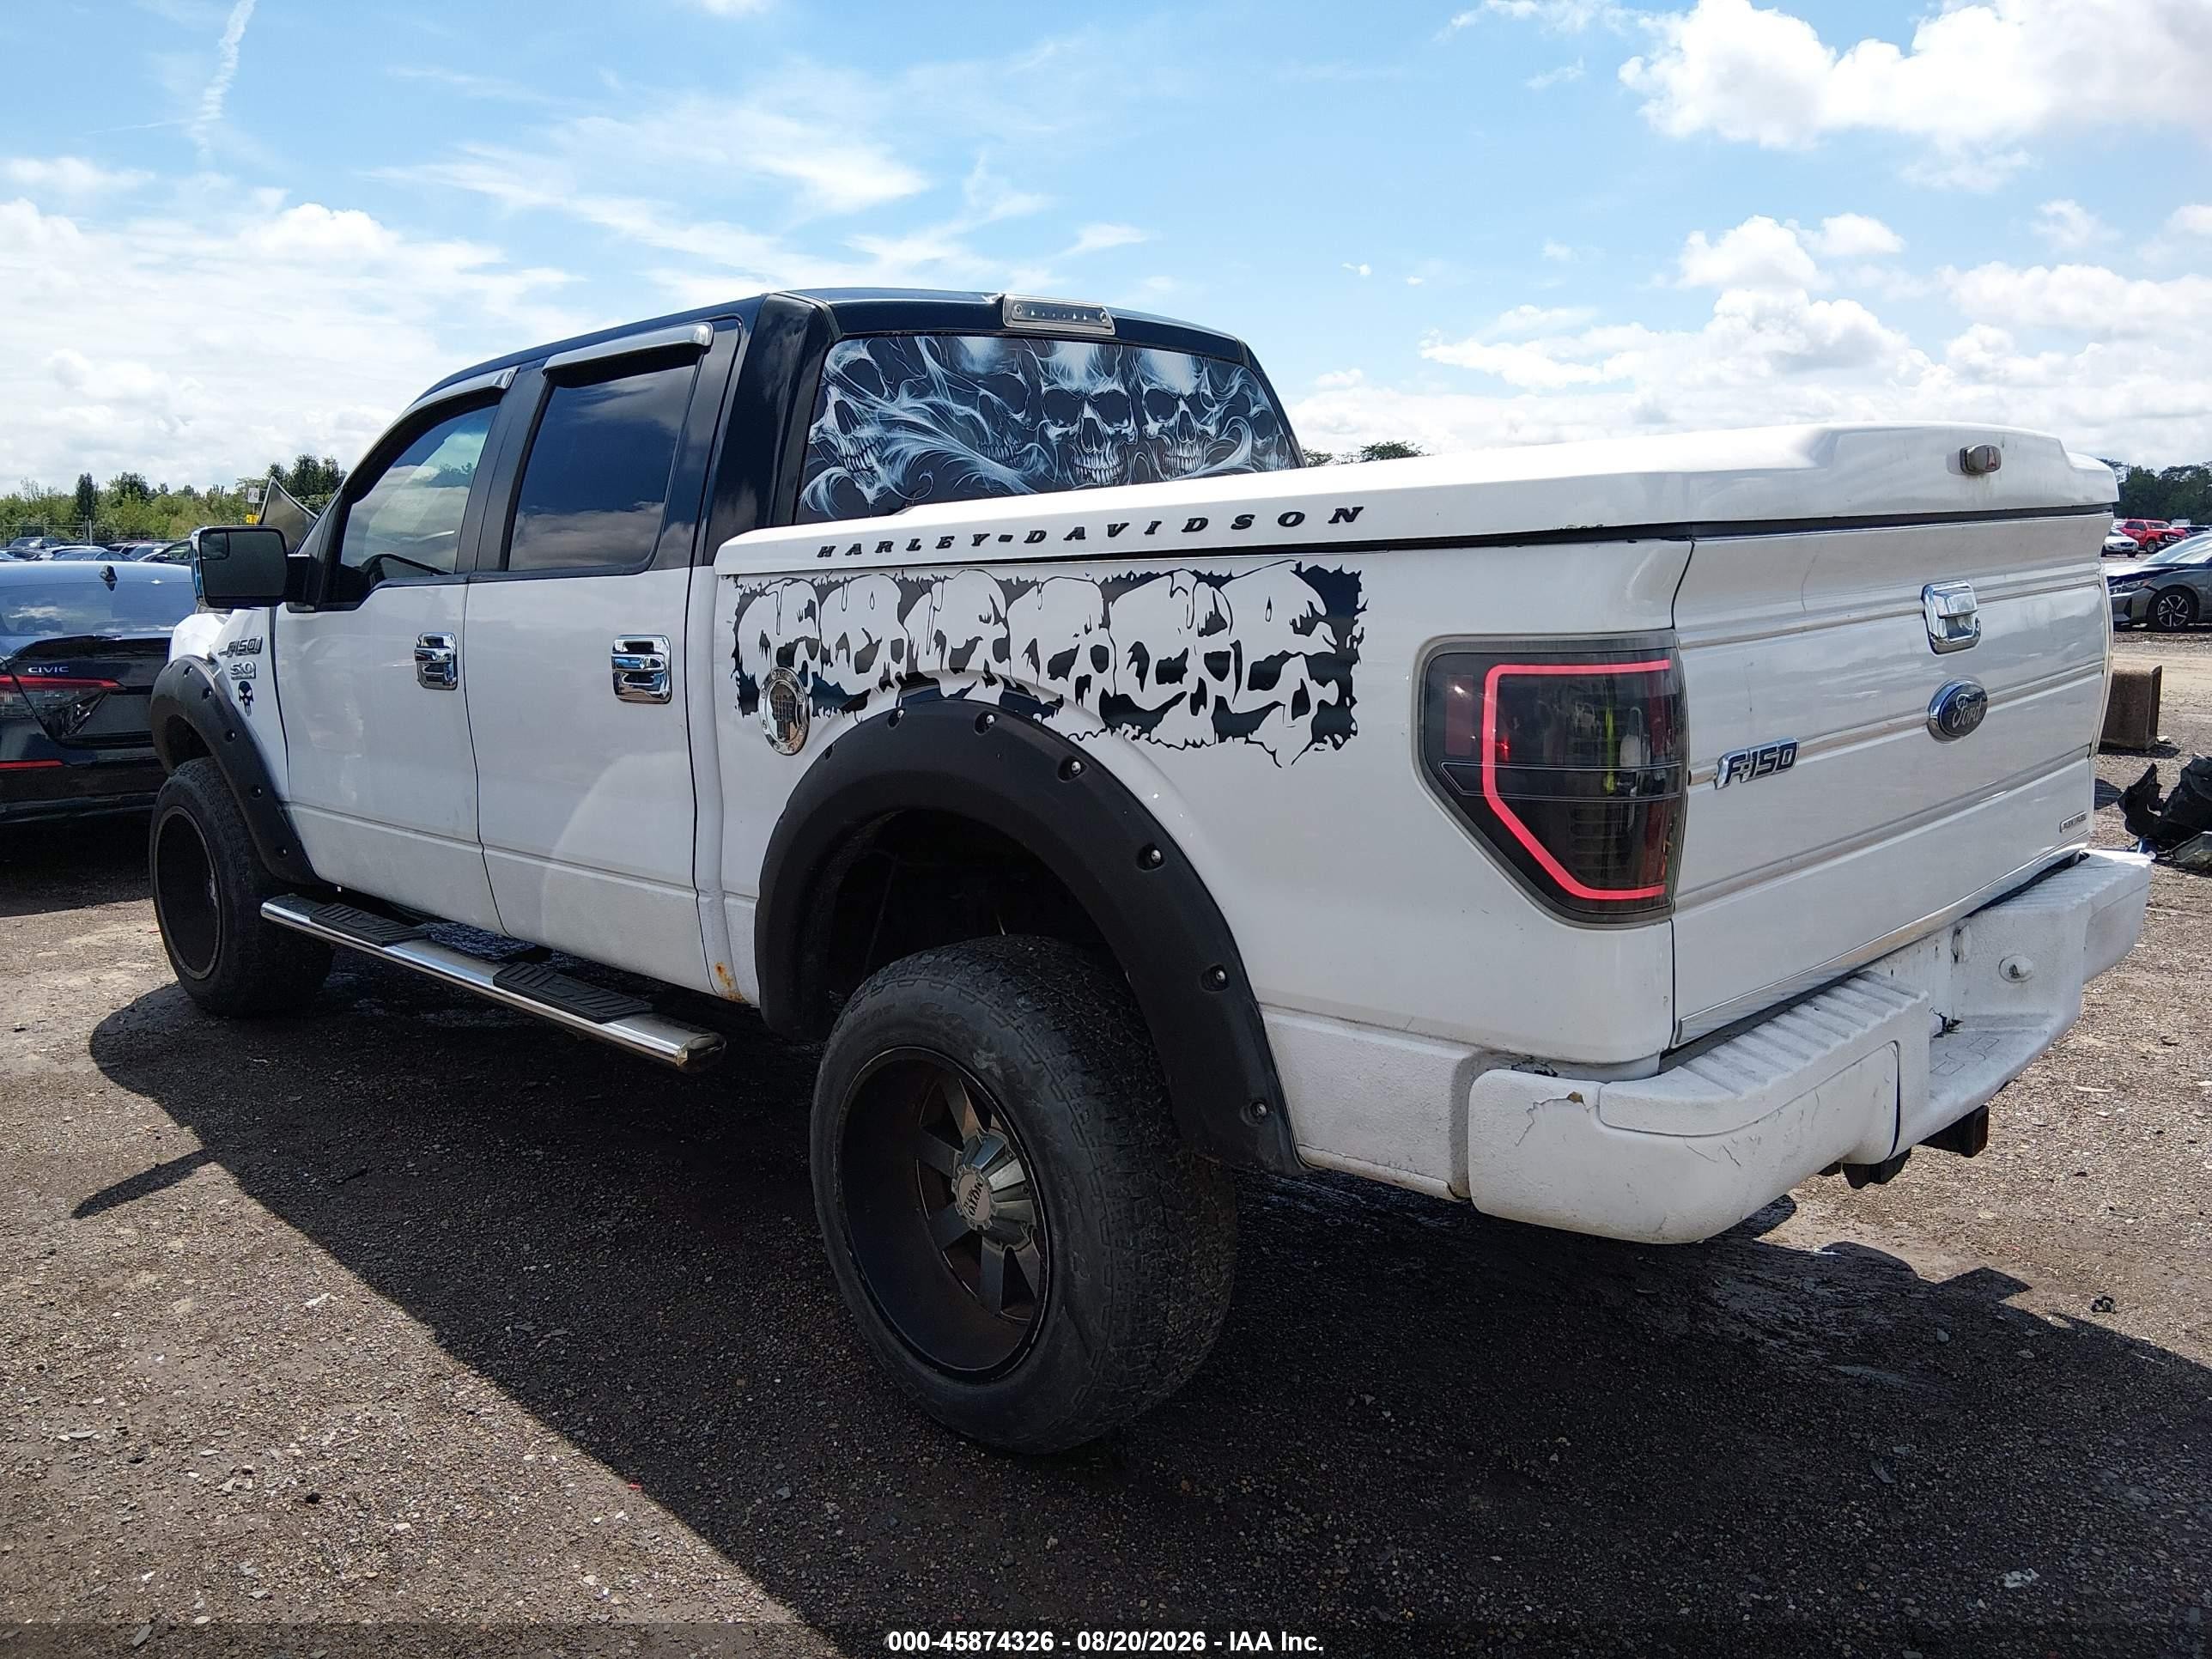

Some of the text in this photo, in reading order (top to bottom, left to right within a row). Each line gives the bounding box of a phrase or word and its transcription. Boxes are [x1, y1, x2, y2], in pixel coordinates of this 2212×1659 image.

[817, 506, 1365, 558] HARLEY-DAVIDSON
[1952, 693, 1983, 728] Ford
[1718, 738, 1800, 789] F-150
[969, 1180, 984, 1216] MOTO
